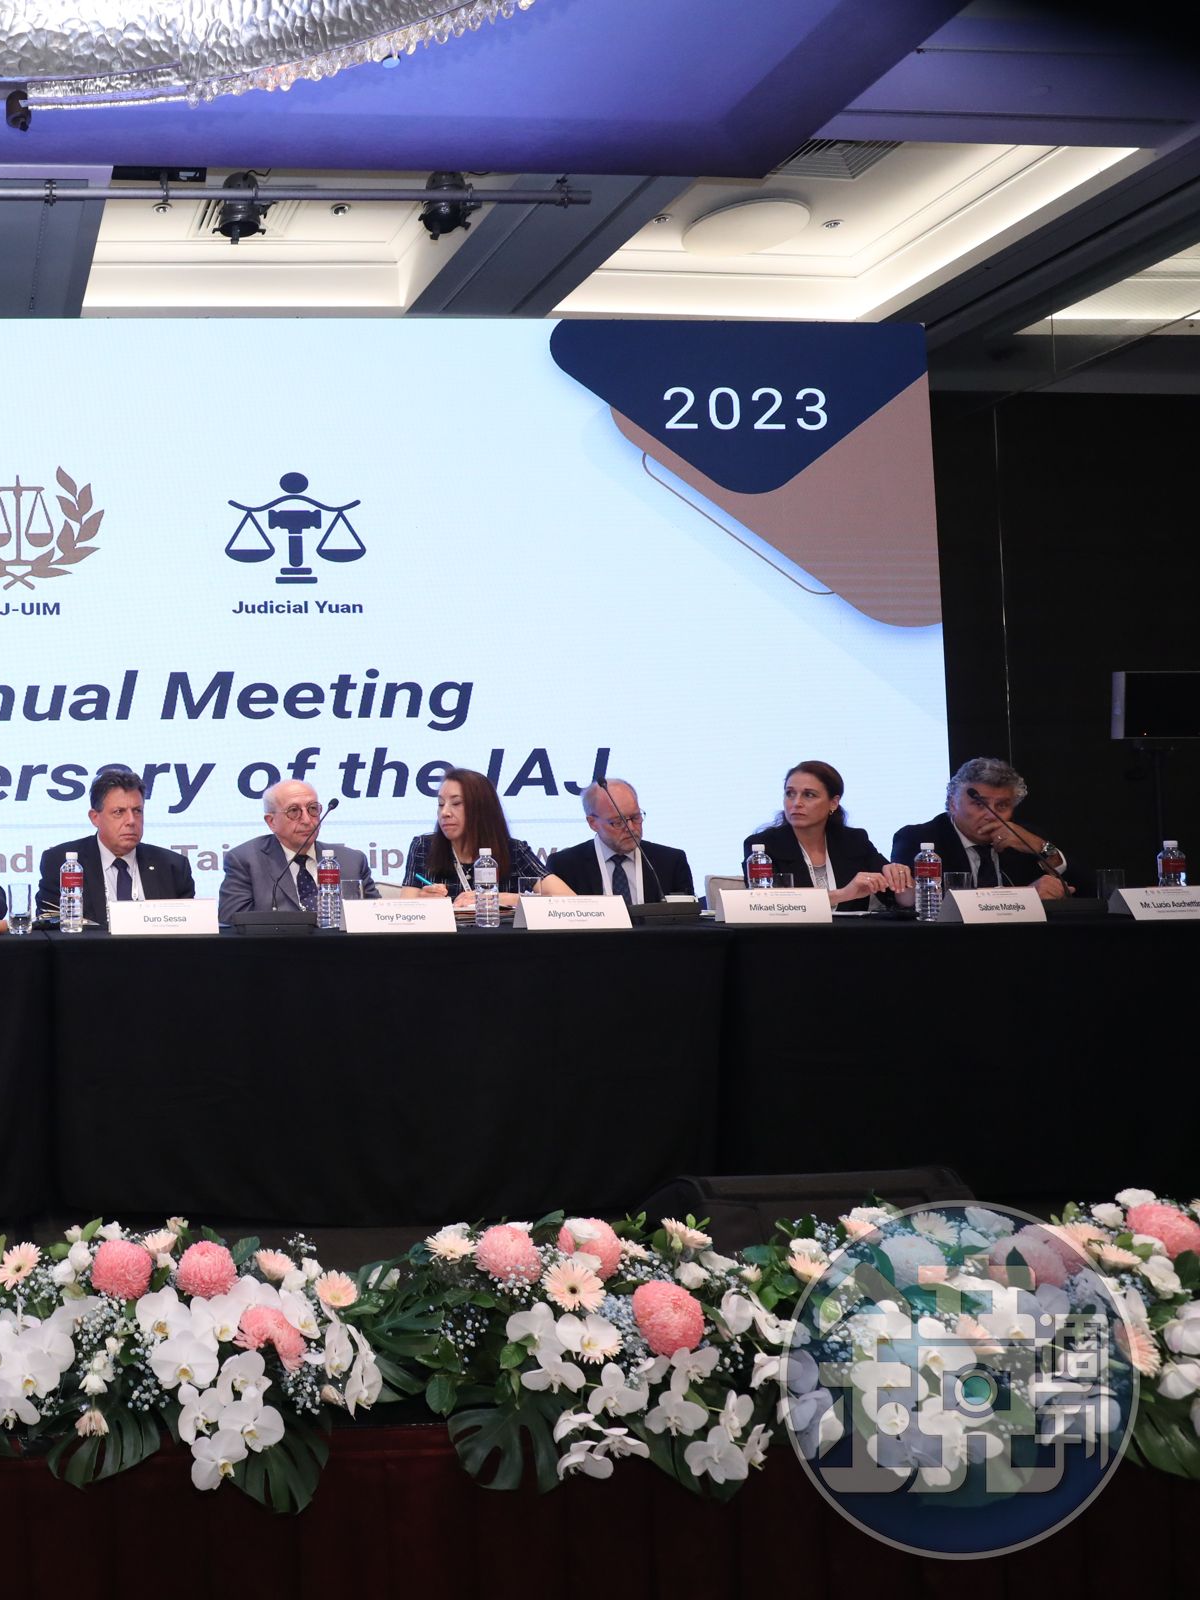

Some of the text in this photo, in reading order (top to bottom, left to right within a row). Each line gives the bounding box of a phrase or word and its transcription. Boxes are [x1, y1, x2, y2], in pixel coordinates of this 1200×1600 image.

[663, 386, 828, 431] 2023
[231, 599, 364, 614] Judicial Yuan
[160, 668, 474, 732] Meeting
[237, 747, 321, 800] of
[338, 747, 455, 798] the
[482, 747, 611, 797] IAJ
[978, 903, 1026, 912] Sabine Matejka
[143, 915, 187, 923] Duro Sessa
[375, 913, 426, 923] Tony Pagone
[548, 910, 605, 920] Allyson Duncan
